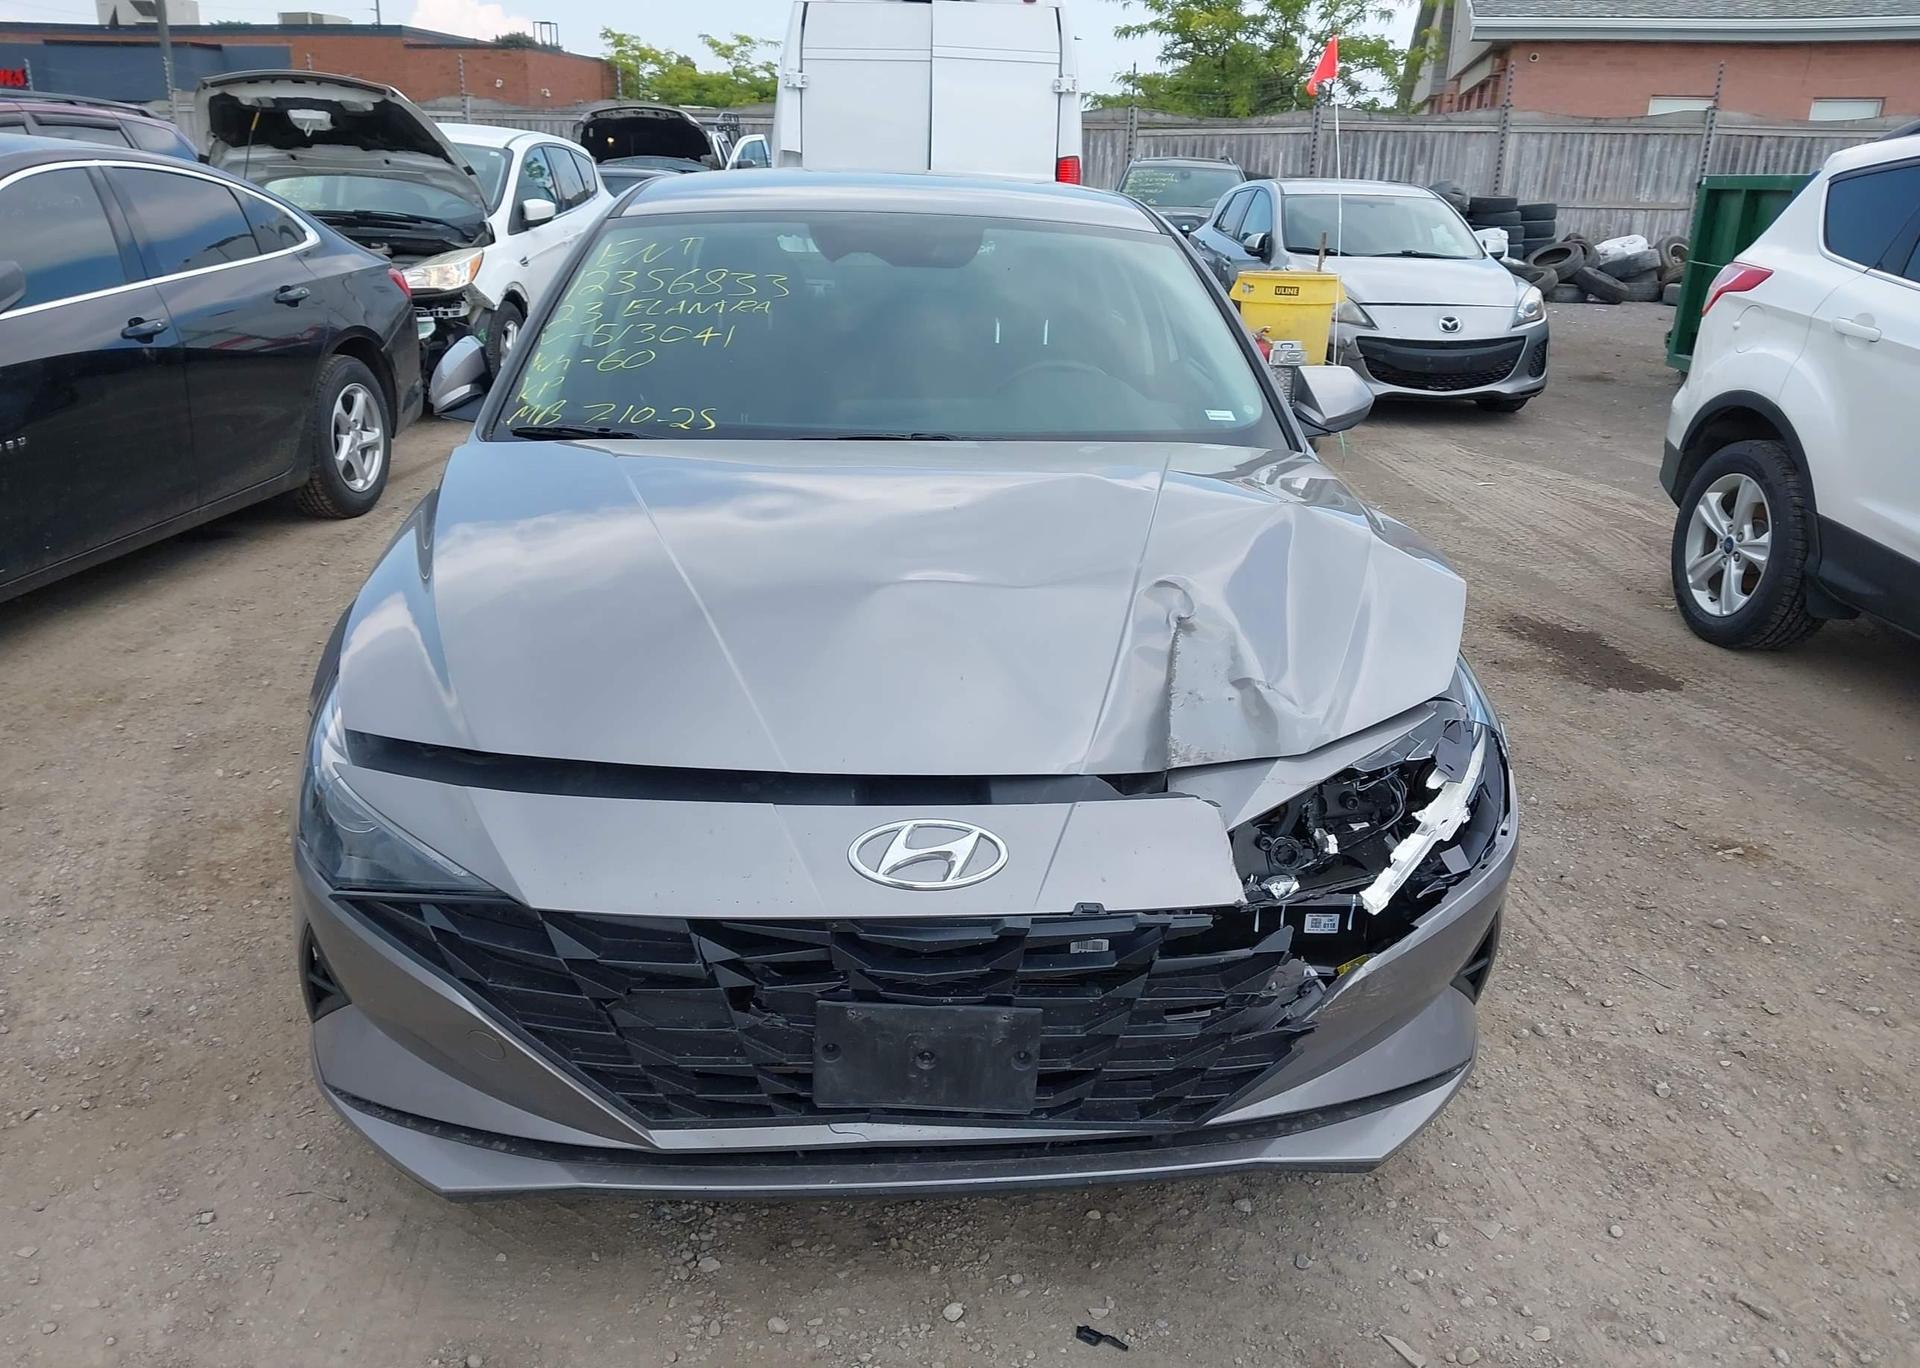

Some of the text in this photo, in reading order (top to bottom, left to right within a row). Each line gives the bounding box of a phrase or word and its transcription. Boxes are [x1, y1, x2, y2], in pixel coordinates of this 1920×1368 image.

[597, 237, 704, 267] ENT
[564, 268, 790, 301] 12356833
[1275, 287, 1299, 296] ULINE
[546, 299, 771, 330] 23 ELANTRA
